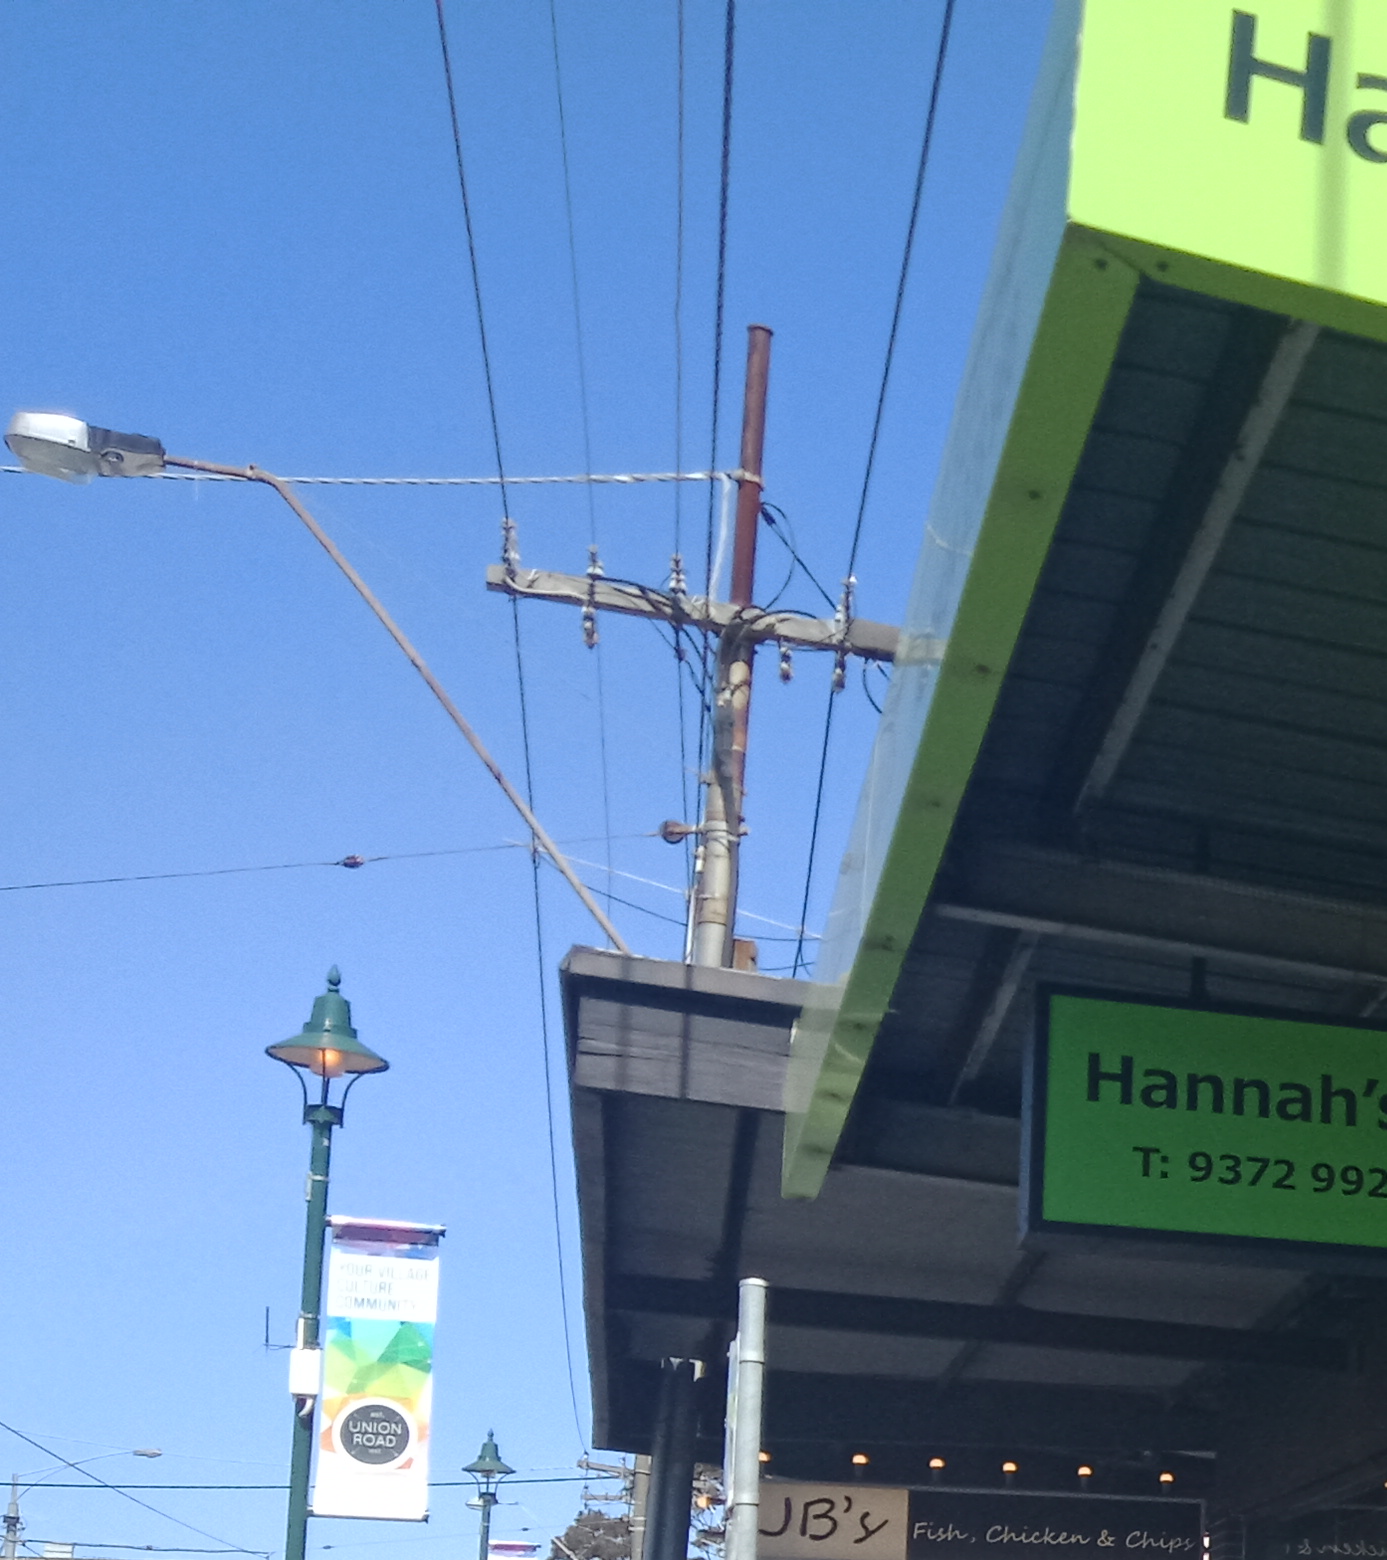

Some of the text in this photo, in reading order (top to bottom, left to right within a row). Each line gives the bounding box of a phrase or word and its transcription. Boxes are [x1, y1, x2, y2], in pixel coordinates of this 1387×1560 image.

[1133, 1147, 1170, 1180] T:
[1187, 1150, 1297, 1192] 9372
[349, 1420, 402, 1435] UNION
[353, 1434, 396, 1447] ROAD
[985, 1525, 1091, 1546] Chicken
[1096, 1529, 1115, 1547] &
[1125, 1530, 1197, 1554] Chips
